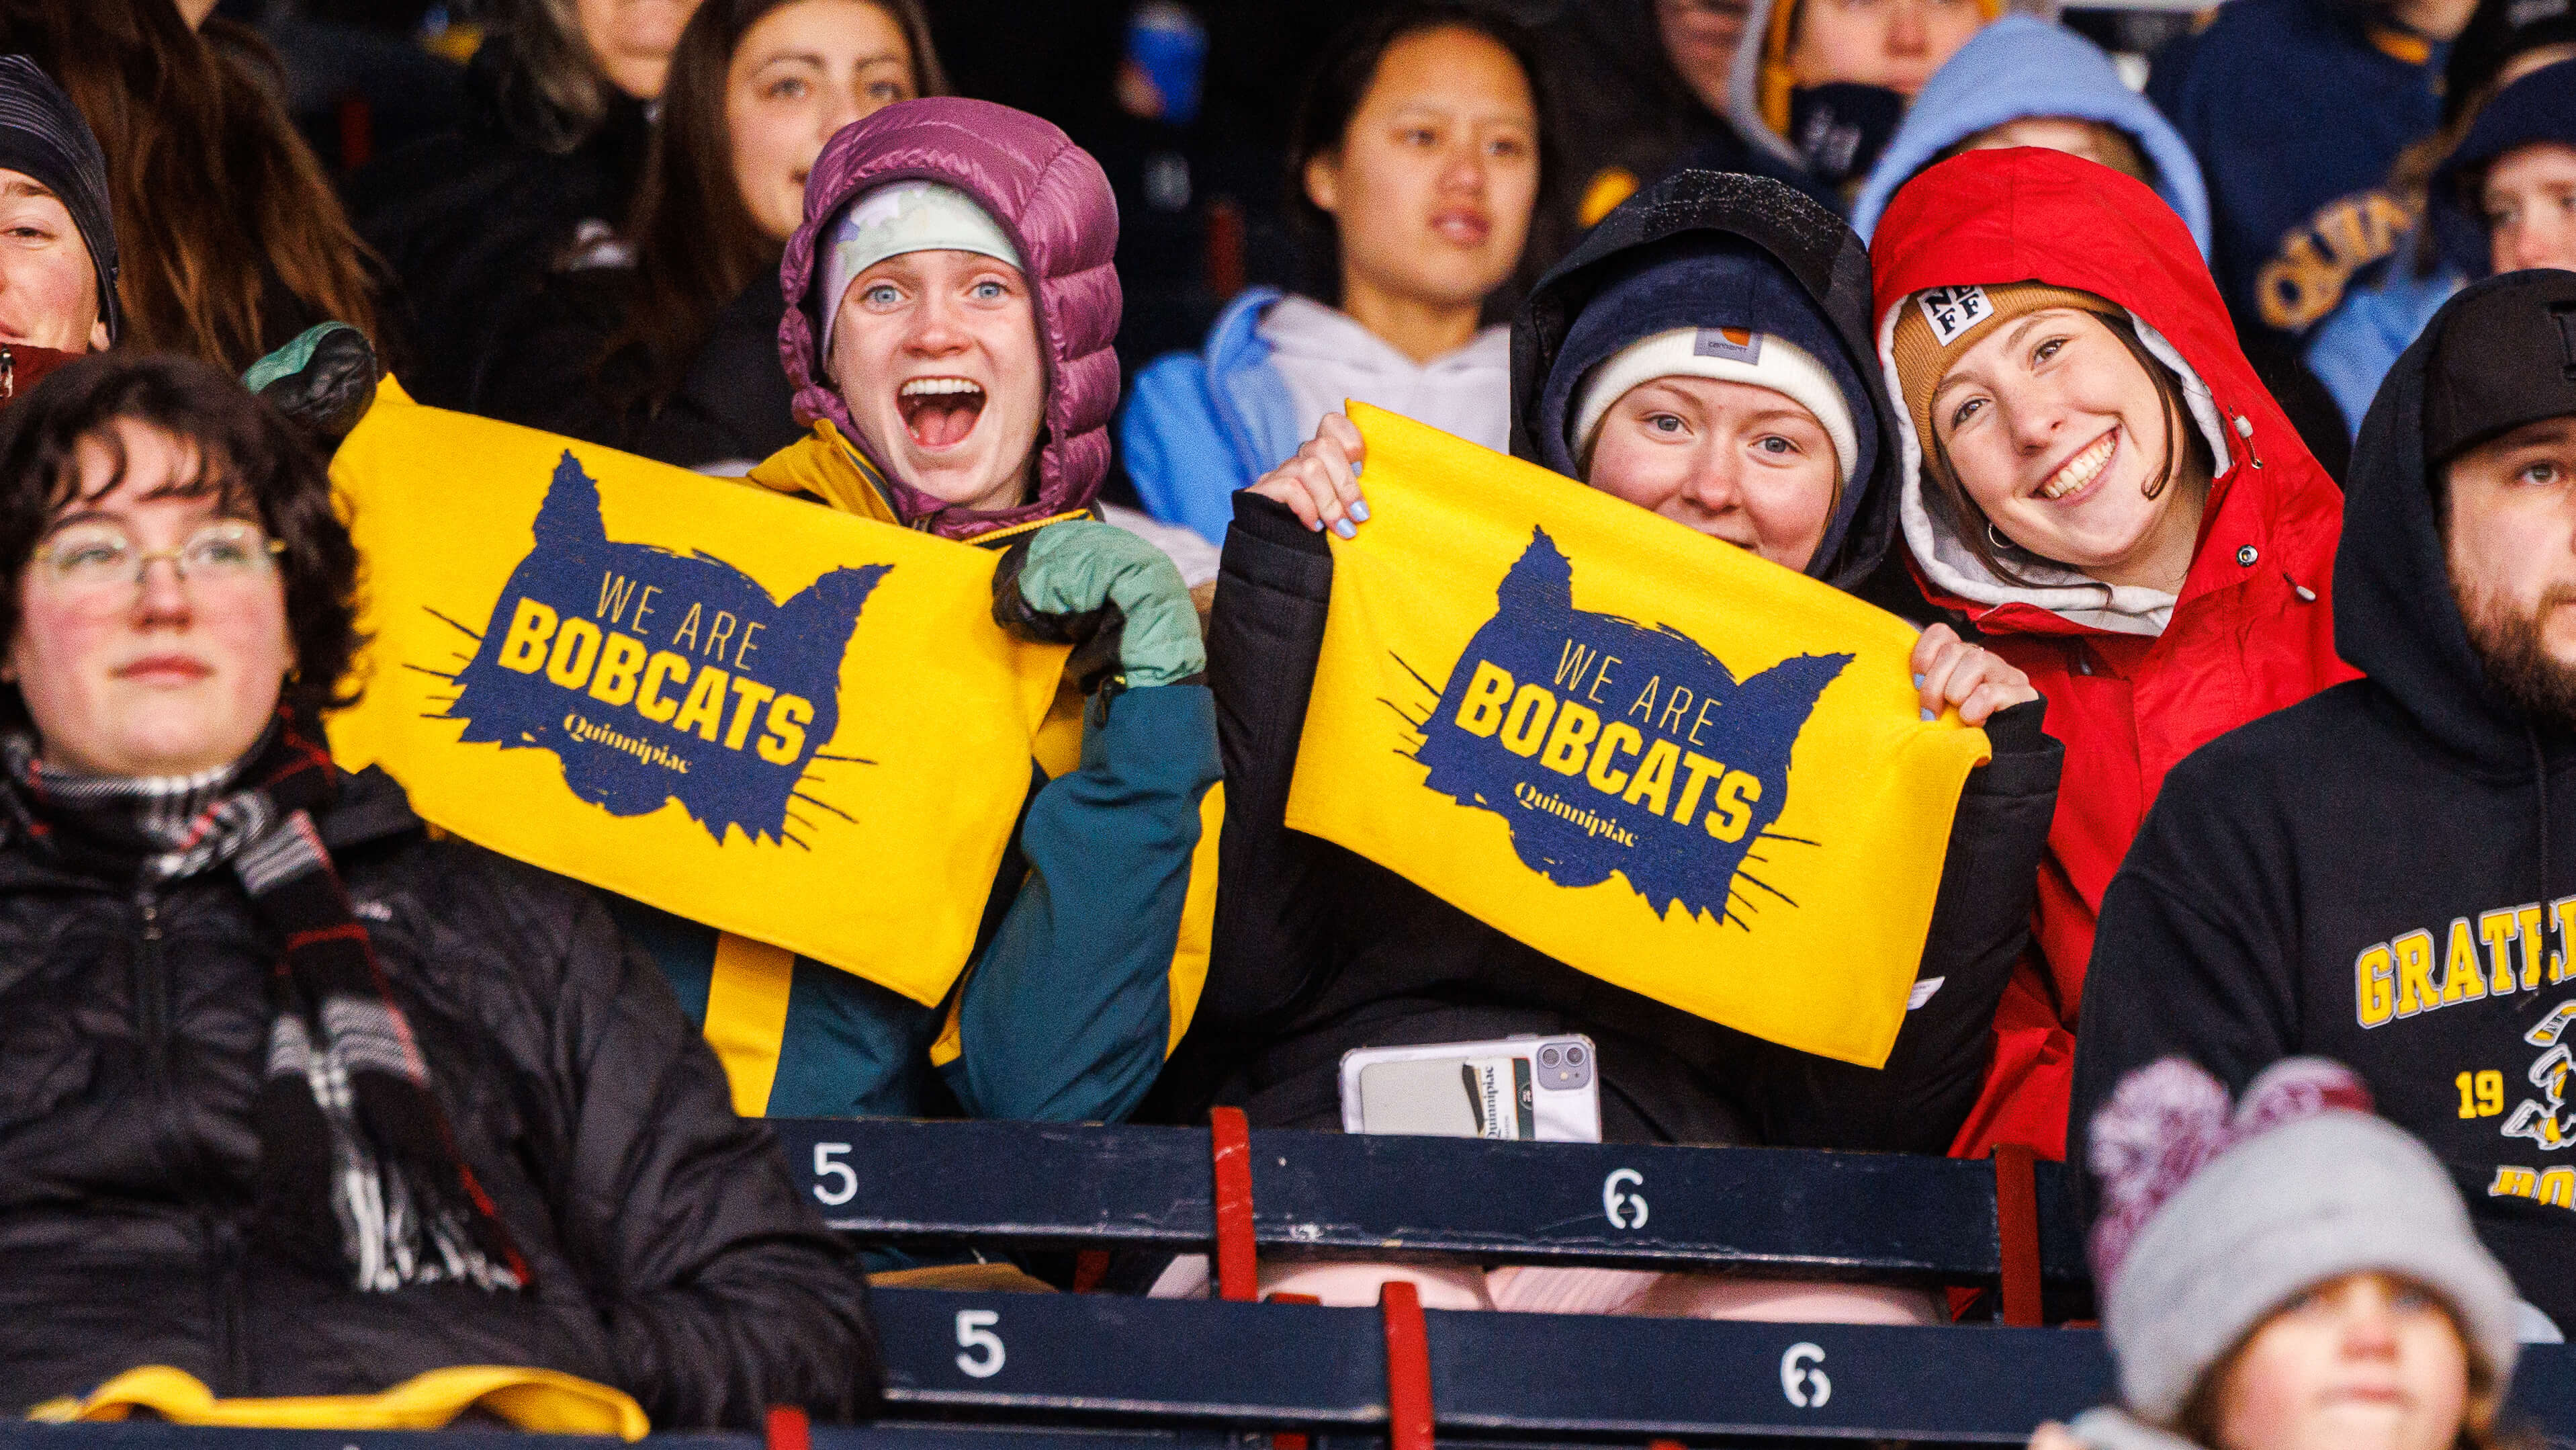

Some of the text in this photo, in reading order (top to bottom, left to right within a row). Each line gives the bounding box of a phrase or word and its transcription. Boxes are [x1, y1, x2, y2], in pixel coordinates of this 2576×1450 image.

[596, 570, 766, 671] WE ARE
[497, 596, 815, 766] BOBCATS
[1554, 638, 1722, 746] WE ARE
[564, 713, 691, 774] Quinnipiac
[1454, 659, 1763, 843] BOBCATS
[1514, 781, 1639, 848] Quinnipiac
[2455, 1070, 2505, 1119] 19
[813, 1142, 858, 1206] 5
[1603, 1168, 1649, 1230] 6
[956, 1310, 1006, 1378] 5
[1780, 1342, 1831, 1408] 6
